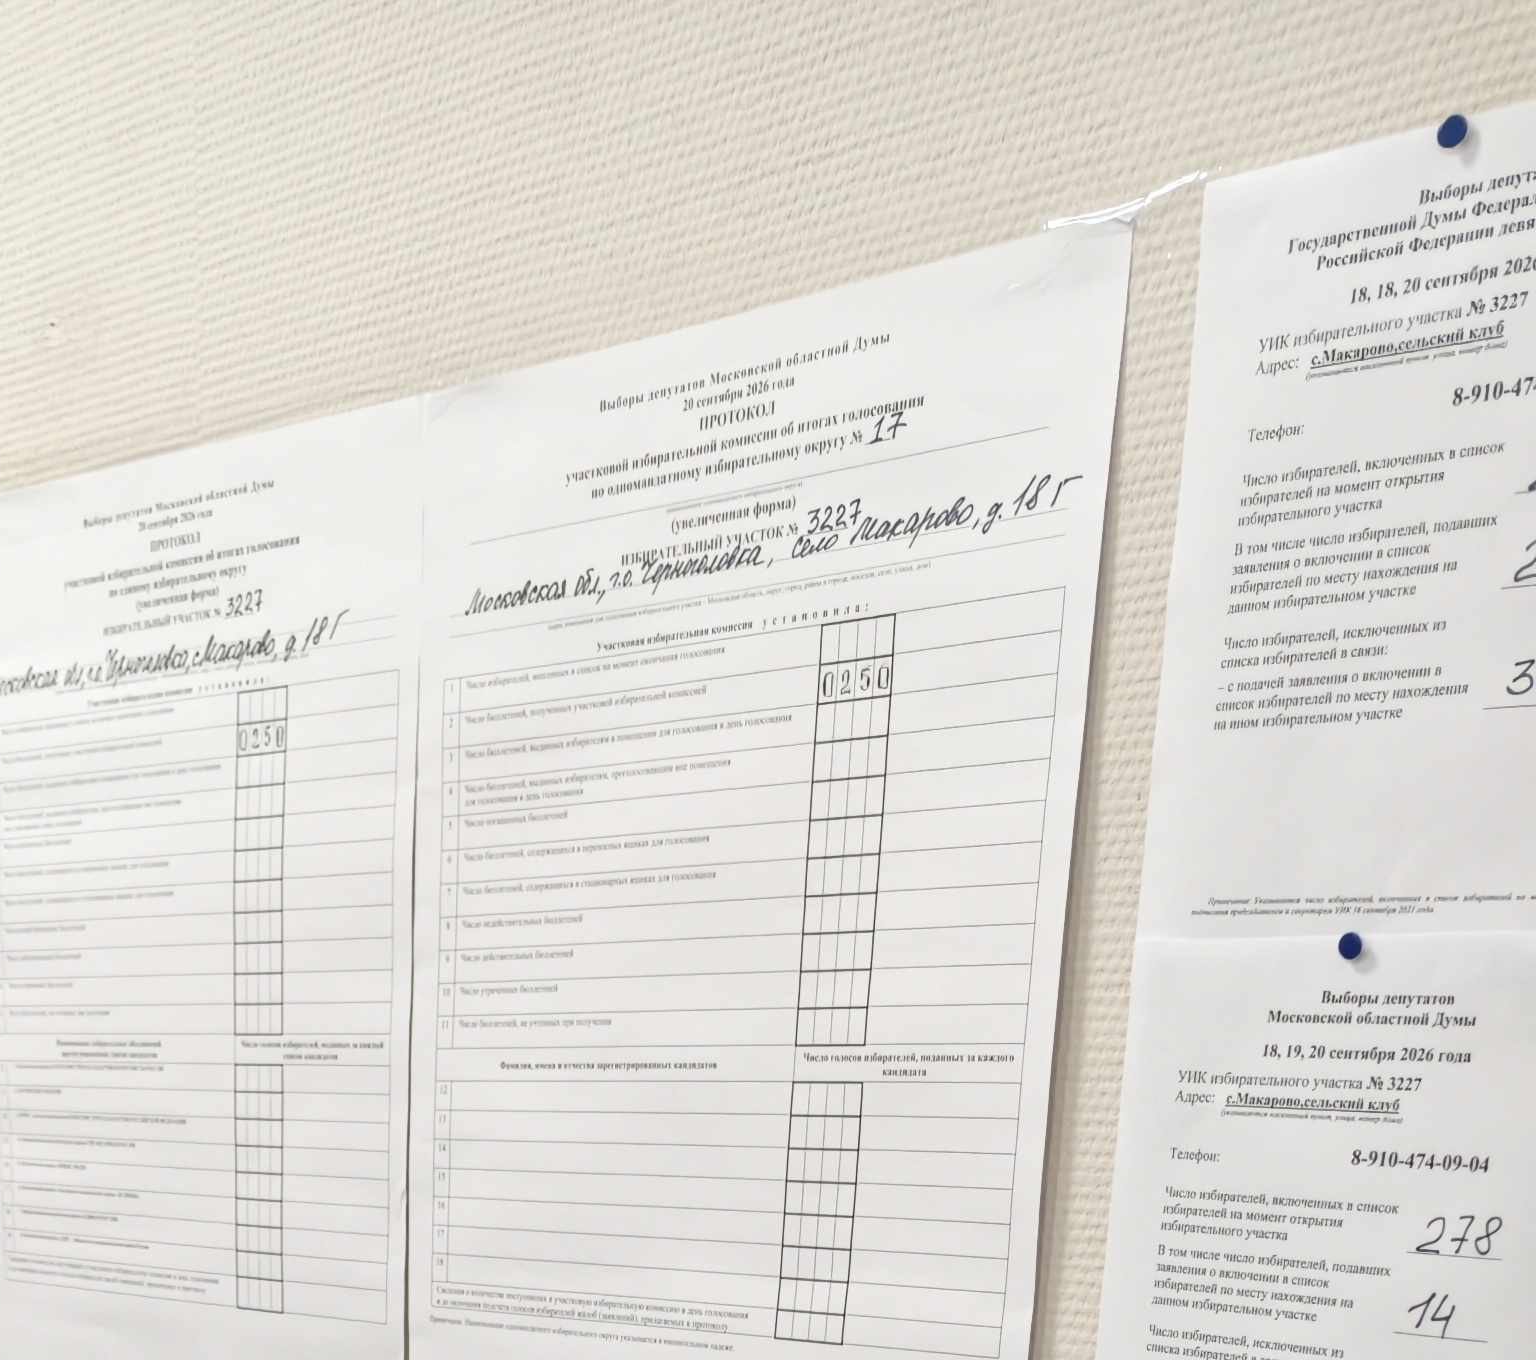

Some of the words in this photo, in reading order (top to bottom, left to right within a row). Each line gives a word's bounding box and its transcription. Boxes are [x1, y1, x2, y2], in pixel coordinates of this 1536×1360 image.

[1418, 181, 1484, 206] Выборы
[1419, 208, 1467, 230] Думы
[1316, 240, 1404, 271] Российской
[1408, 226, 1495, 253] Федерации
[1350, 286, 1371, 305] 18,
[1377, 281, 1398, 300] 18,
[1402, 277, 1421, 295] 20
[1424, 264, 1499, 291] сентября
[1259, 333, 1290, 354] УИК
[1293, 318, 1404, 348] избирательного
[1406, 306, 1462, 330] участка
[1465, 298, 1486, 317] №
[1489, 291, 1529, 313] 3227
[599, 393, 644, 413] Выборы
[647, 379, 705, 402] депутатов
[710, 357, 782, 385] Московской
[786, 340, 849, 367] областной
[852, 333, 890, 353] Думы
[1255, 357, 1300, 376] Адрес:
[683, 397, 694, 412] 20
[696, 388, 743, 409] сентября
[746, 380, 770, 398] 2026
[772, 376, 795, 391] года
[699, 400, 775, 431] ПРОТОКОЛ
[869, 411, 907, 444] 17
[565, 458, 629, 487] участковой
[720, 428, 778, 451] комиссии
[780, 423, 794, 437] об
[797, 415, 838, 434] итогах
[842, 396, 925, 424] голосования
[1248, 424, 1305, 443] Телефон:
[591, 487, 605, 499] по
[804, 435, 847, 455] округу
[849, 430, 863, 445] №
[1243, 473, 1278, 488] Число
[1281, 459, 1361, 483] избирателей,
[1364, 451, 1445, 471] включенных
[1448, 449, 1456, 460] в
[1459, 442, 1506, 458] список
[1240, 485, 1313, 507] избирателей
[1316, 486, 1331, 497] на
[1334, 479, 1382, 495] момент
[1384, 471, 1445, 490] открытия
[752, 495, 796, 520] форма)
[806, 498, 862, 536] 3227
[726, 525, 784, 550] УЧАСТОК
[786, 522, 801, 539] №
[225, 589, 263, 616] 3227
[1321, 990, 1379, 1008] Выборы
[1381, 994, 1455, 1009] депутатов
[1267, 1010, 1353, 1024] Московской
[1356, 1011, 1430, 1026] областной
[1431, 1012, 1477, 1030] Думы
[1263, 1043, 1282, 1060] 18,
[1286, 1044, 1305, 1061] 19,
[1308, 1045, 1326, 1059] 20
[1329, 1046, 1396, 1065] сентября
[1399, 1047, 1434, 1062] 2026
[1438, 1051, 1472, 1064] года
[1178, 1069, 1208, 1084] УИК
[1210, 1071, 1310, 1089] избирательного
[1311, 1078, 1363, 1092] участка
[1365, 1075, 1384, 1091] №
[1386, 1076, 1423, 1092] 3227
[1174, 1089, 1216, 1107] Адрес:
[1169, 1147, 1220, 1165] Телефон:
[1350, 1149, 1490, 1173] 8-910-474-09-04
[1165, 1186, 1197, 1199] Число
[1198, 1189, 1269, 1207] избирателей,
[1272, 1196, 1344, 1211] включенных
[1346, 1202, 1354, 1211] в
[1356, 1203, 1400, 1215] список
[1160, 1219, 1243, 1237] избирательного
[1244, 1228, 1288, 1241] участка
[1162, 1203, 1227, 1219] избирателей
[1230, 1210, 1243, 1220] на
[1245, 1211, 1288, 1224] момент
[1289, 1215, 1344, 1229] открытия
[1415, 1215, 1503, 1256] 278
[1157, 1243, 1166, 1256] В
[1168, 1248, 1188, 1258] том
[1190, 1250, 1221, 1261] числе
[1223, 1253, 1255, 1264] число
[1257, 1254, 1329, 1273] избирателей,
[1331, 1263, 1391, 1277] подавших
[1156, 1263, 1207, 1277] заявления
[1209, 1268, 1217, 1277] о
[1218, 1269, 1280, 1284] включении
[1282, 1275, 1289, 1285] в
[1291, 1276, 1330, 1289] список
[1407, 1292, 1456, 1339] 14
